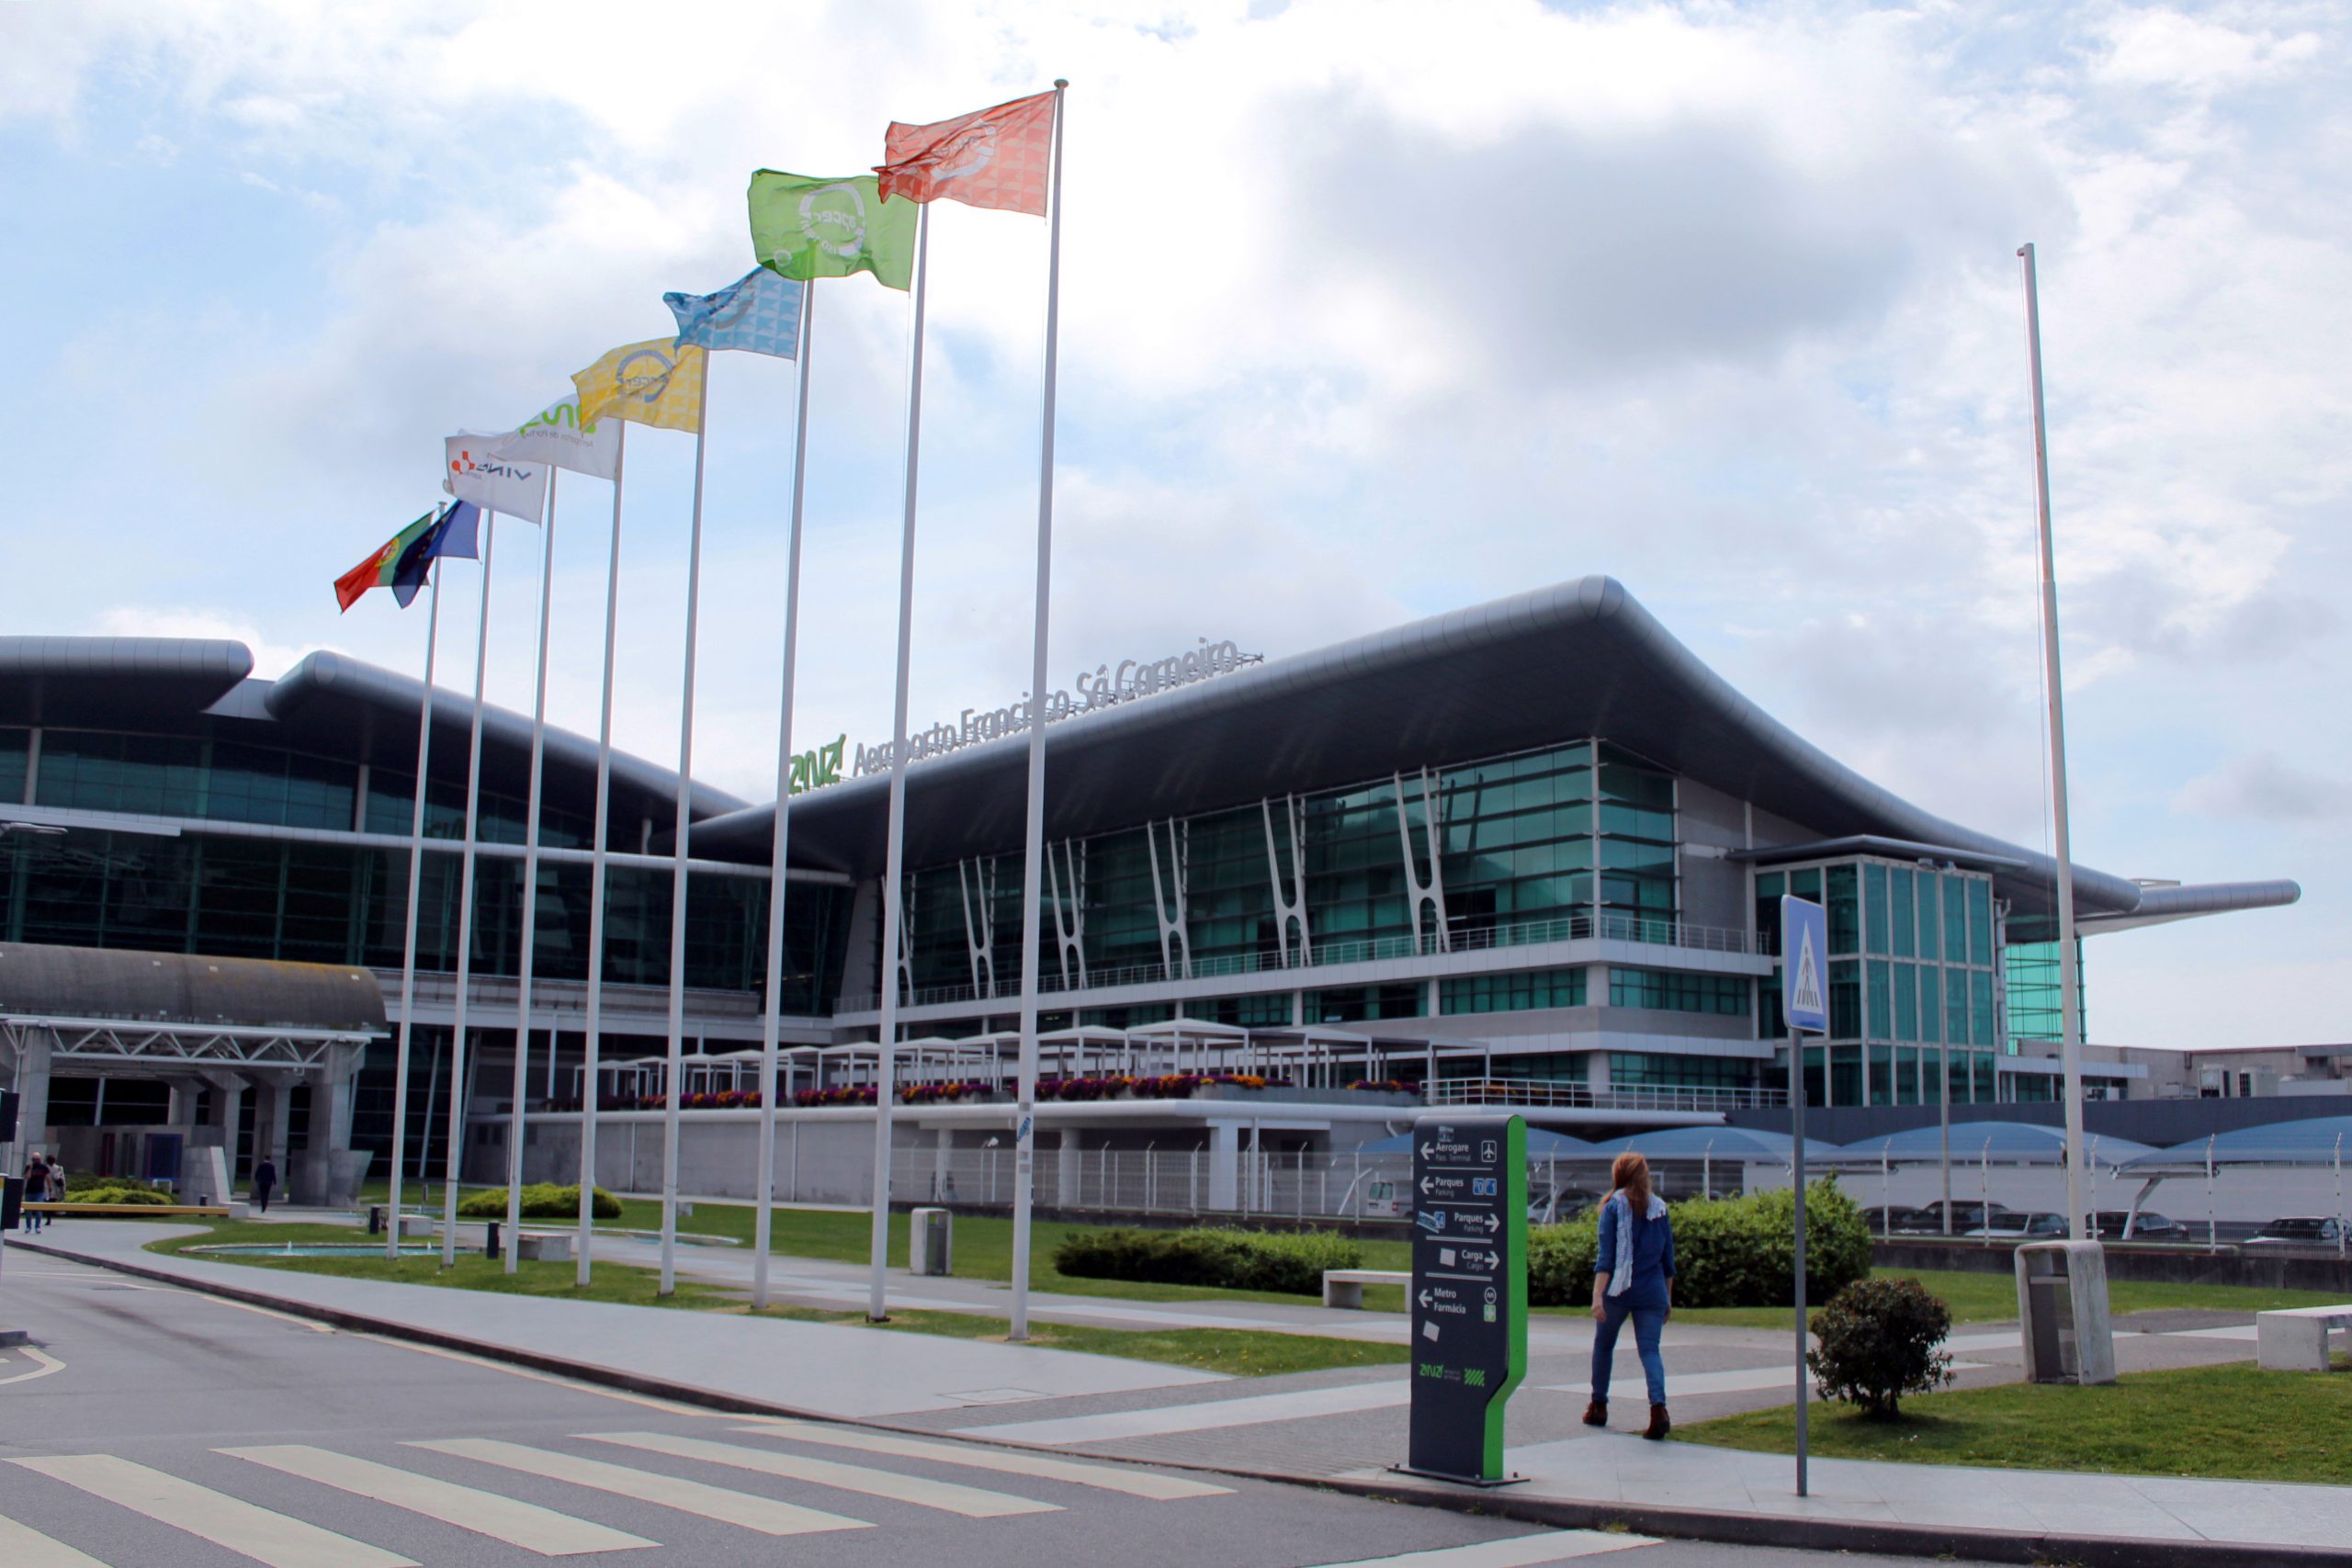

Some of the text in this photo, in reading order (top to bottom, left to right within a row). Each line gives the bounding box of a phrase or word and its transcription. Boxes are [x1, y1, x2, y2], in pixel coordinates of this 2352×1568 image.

[1076, 663, 1110, 714] Sá
[1114, 637, 1239, 702] Carneiro
[1435, 1142, 1469, 1155] Aerogare
[1435, 1177, 1464, 1189] Parques
[1454, 1213, 1483, 1224] Parques
[1464, 1224, 1484, 1235] Parking
[1462, 1250, 1483, 1262] Carga
[1466, 1262, 1484, 1272] Cargo
[1434, 1287, 1456, 1299] Metro
[1433, 1302, 1466, 1314] Farmácia
